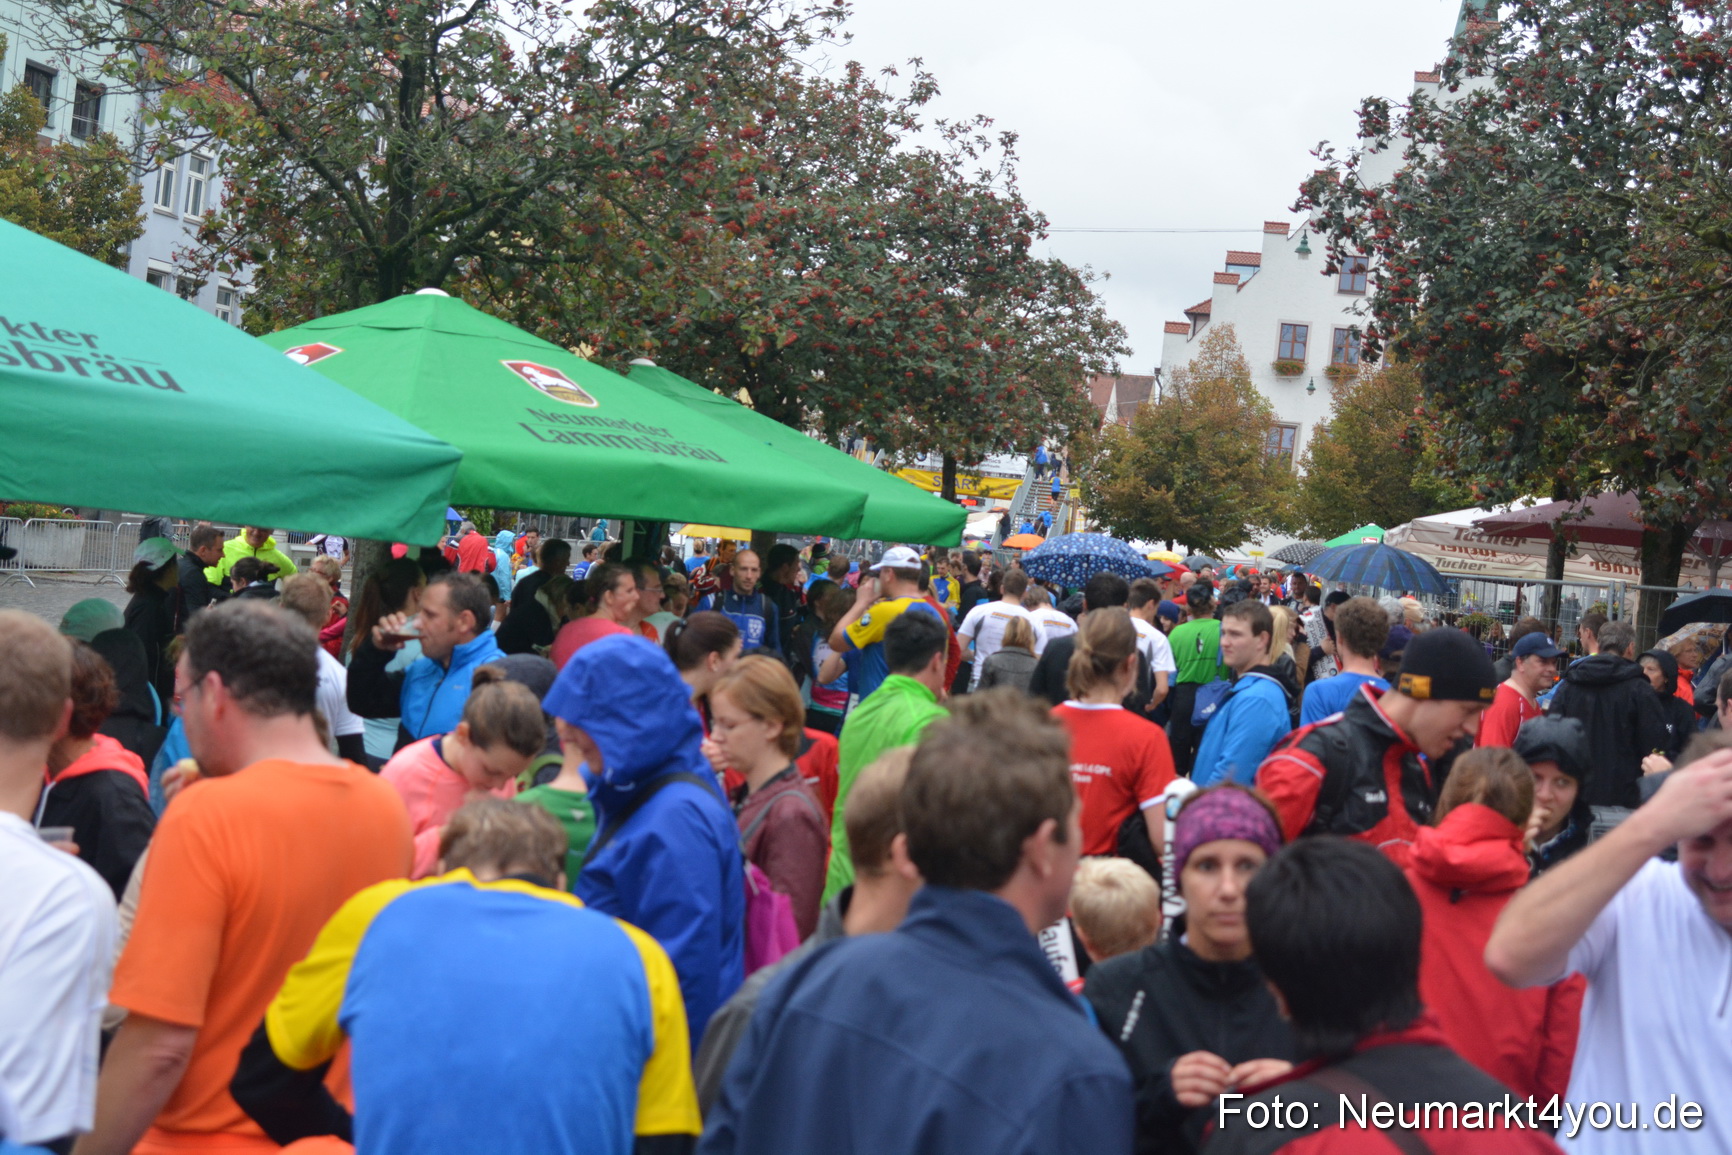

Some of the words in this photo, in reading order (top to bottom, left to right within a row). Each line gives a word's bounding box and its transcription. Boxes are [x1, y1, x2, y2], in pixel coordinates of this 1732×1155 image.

[0, 315, 99, 349] kter
[525, 407, 675, 439] Neumarkter
[517, 422, 729, 464] Lammsbräu
[932, 475, 979, 491] SART
[1435, 557, 1487, 571] Tucher
